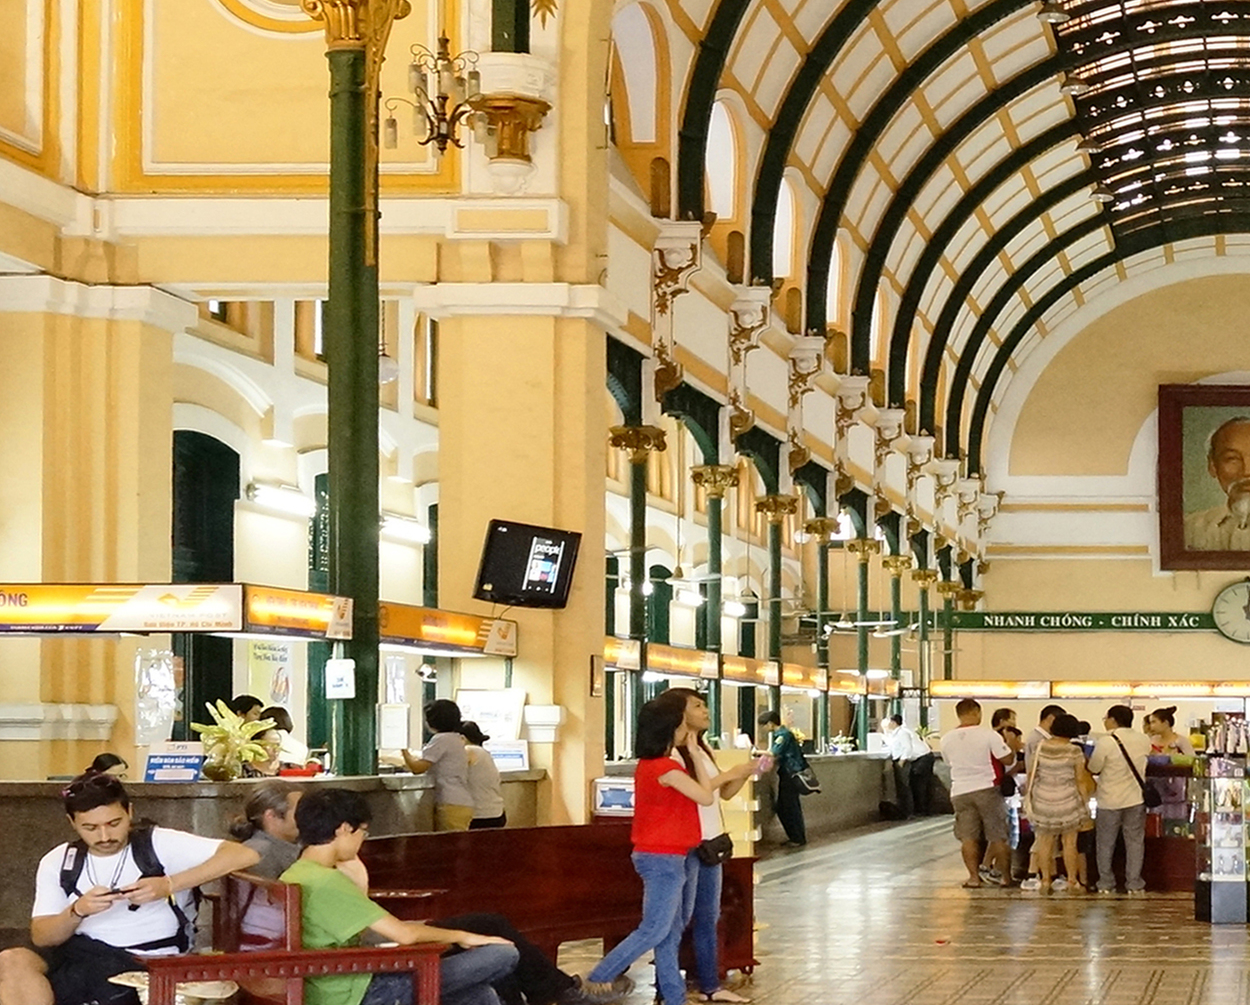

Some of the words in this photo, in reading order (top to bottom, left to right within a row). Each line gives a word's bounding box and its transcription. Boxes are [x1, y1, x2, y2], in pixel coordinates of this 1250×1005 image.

[983, 615, 1036, 627] NHANH
[1040, 612, 1093, 627] CHÓNG
[1111, 612, 1161, 627] CHÍNH
[1168, 612, 1200, 627] XÁC
